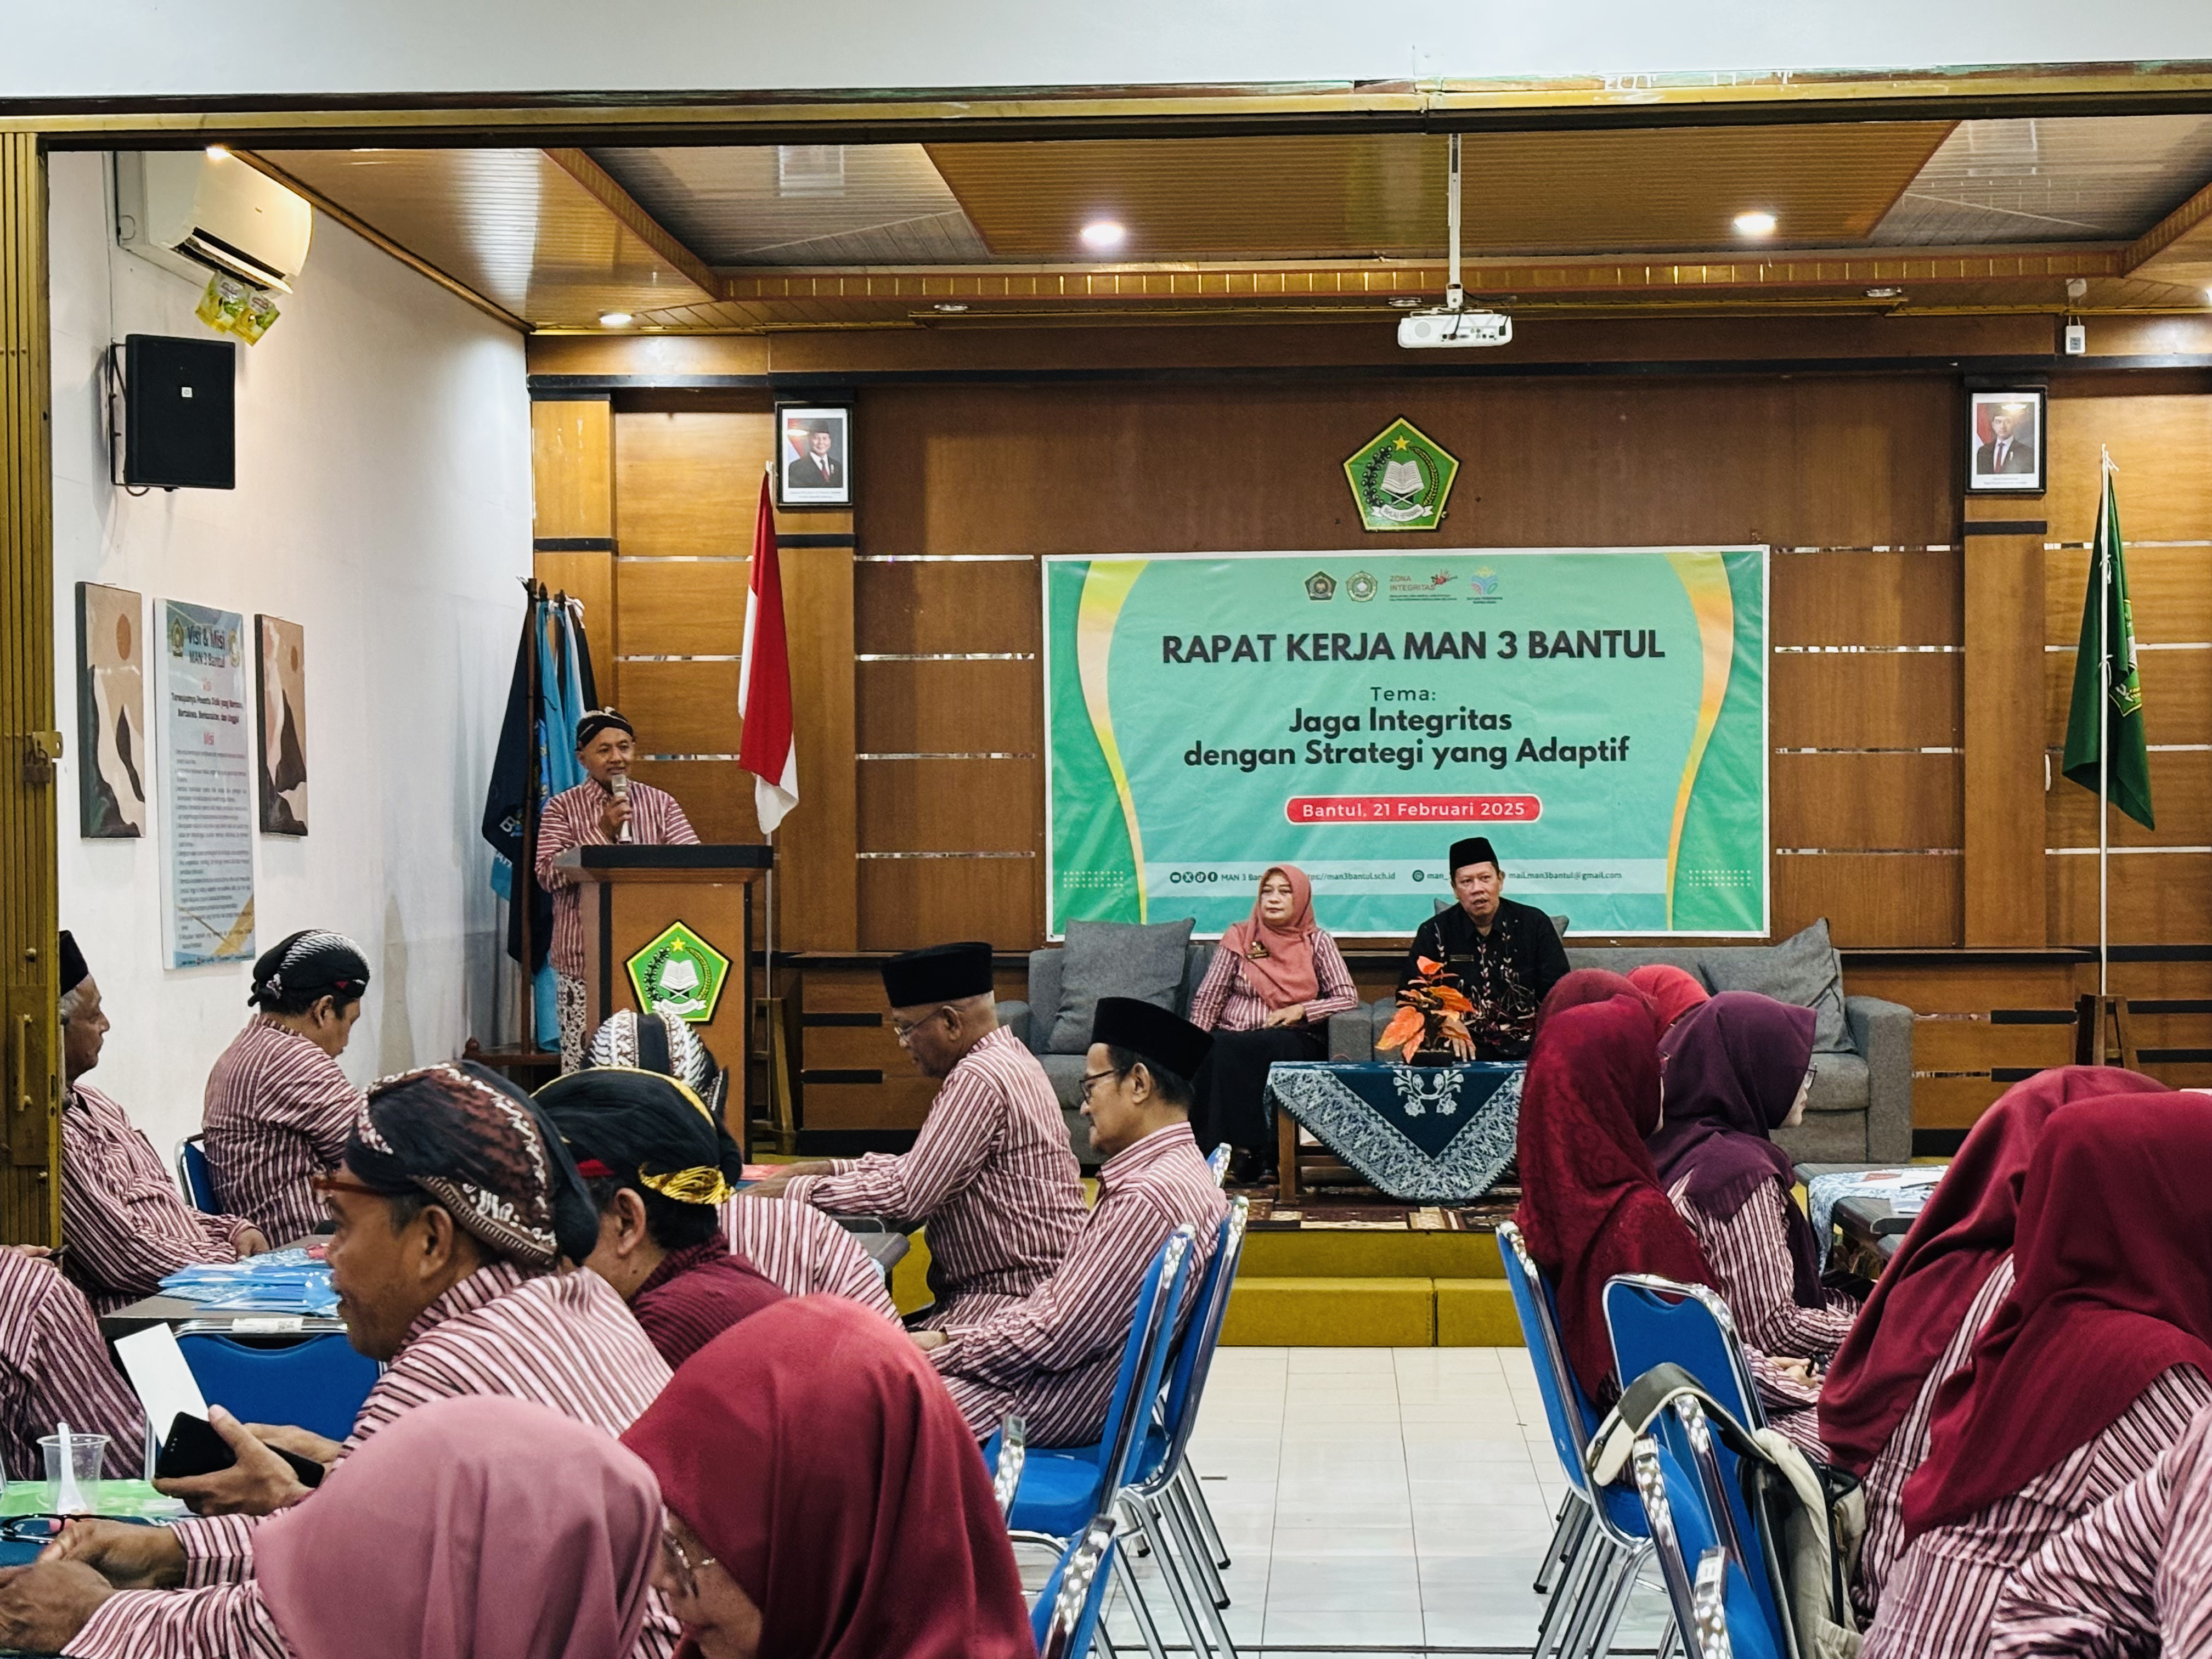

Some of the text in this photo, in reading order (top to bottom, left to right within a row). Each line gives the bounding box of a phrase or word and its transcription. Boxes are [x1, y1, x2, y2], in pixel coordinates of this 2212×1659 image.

[1163, 629, 1666, 664] RAPAT KERJA MAN 3 BANTUL
[1370, 687, 1436, 701] Tema:
[1289, 706, 1513, 739] Jaga Integritas
[1184, 736, 1630, 772] dengan Strategi yang Adaptif
[1373, 803, 1391, 817] 21
[1398, 802, 1474, 816] Februari
[1481, 802, 1525, 815] 2025
